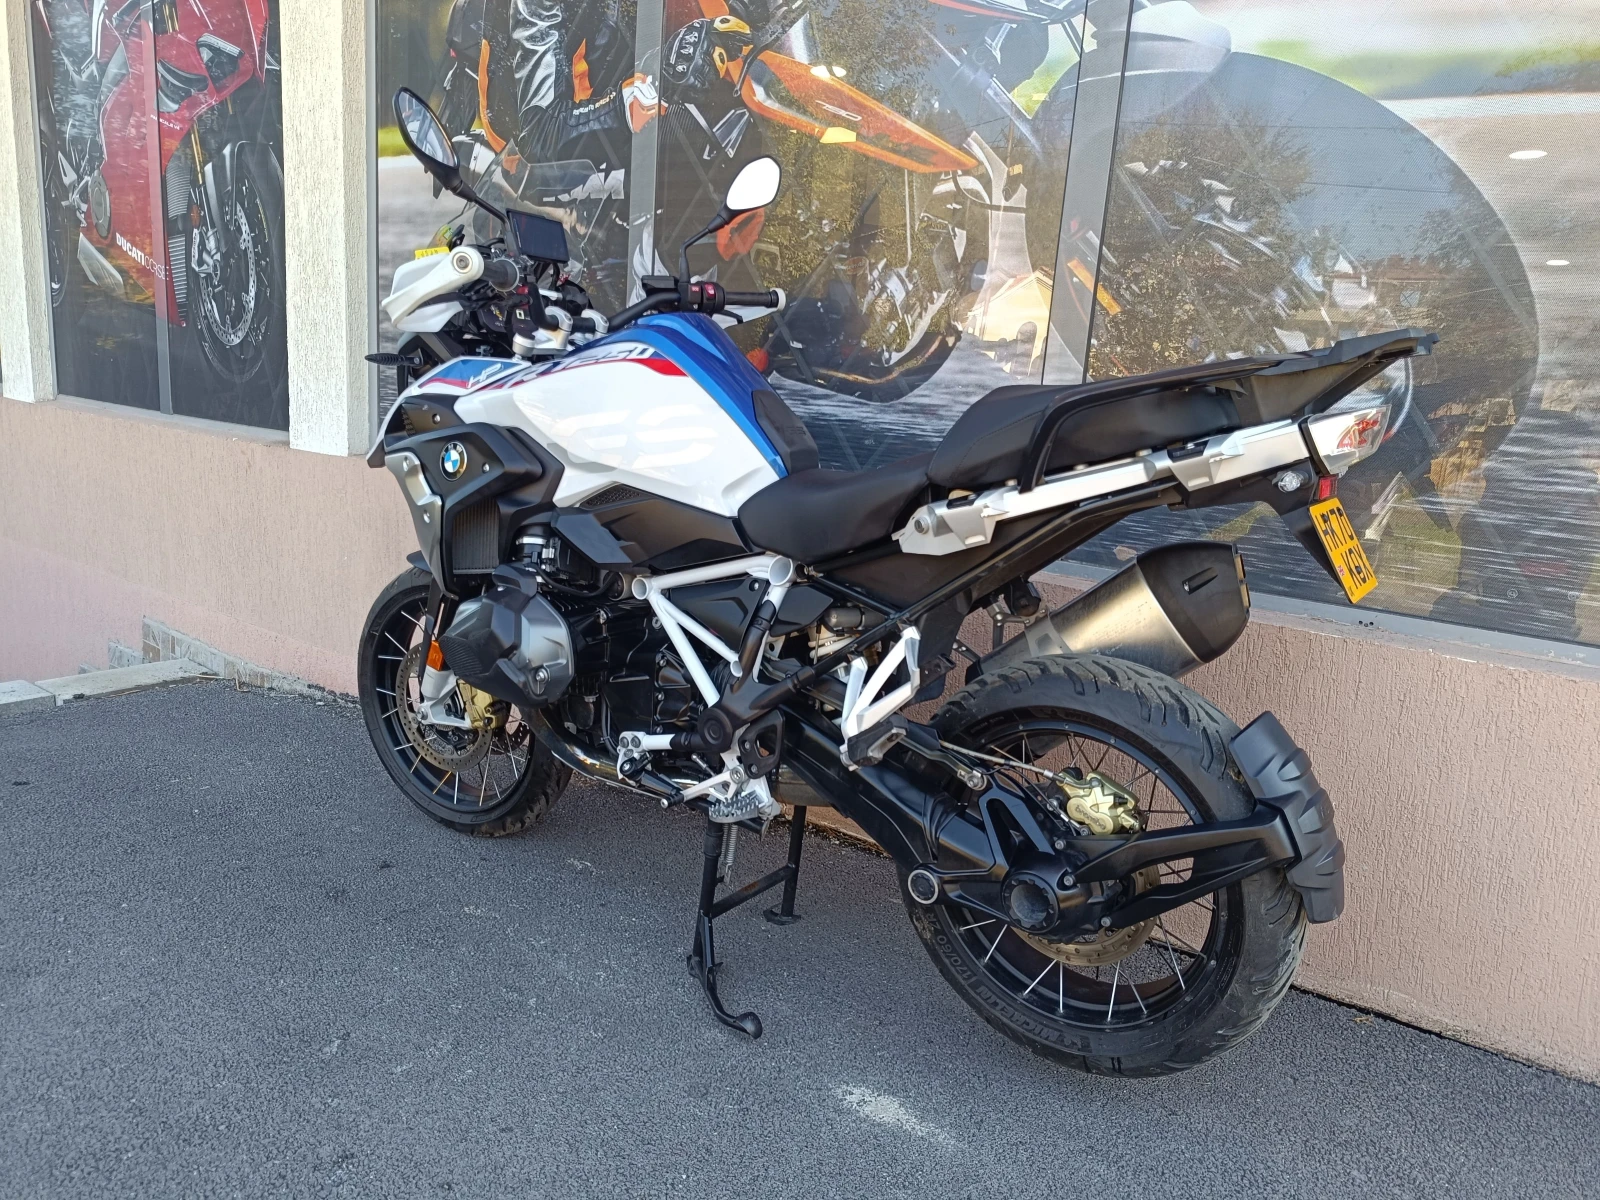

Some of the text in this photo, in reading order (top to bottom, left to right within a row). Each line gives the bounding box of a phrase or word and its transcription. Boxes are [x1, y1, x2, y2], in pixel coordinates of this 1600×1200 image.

[116, 232, 144, 266] DUCATI
[466, 363, 504, 389] HP
[551, 346, 656, 373] 1250
[1315, 507, 1355, 552] HK70
[935, 934, 972, 980] 170/60
[975, 982, 1061, 1045] MICHELIN
